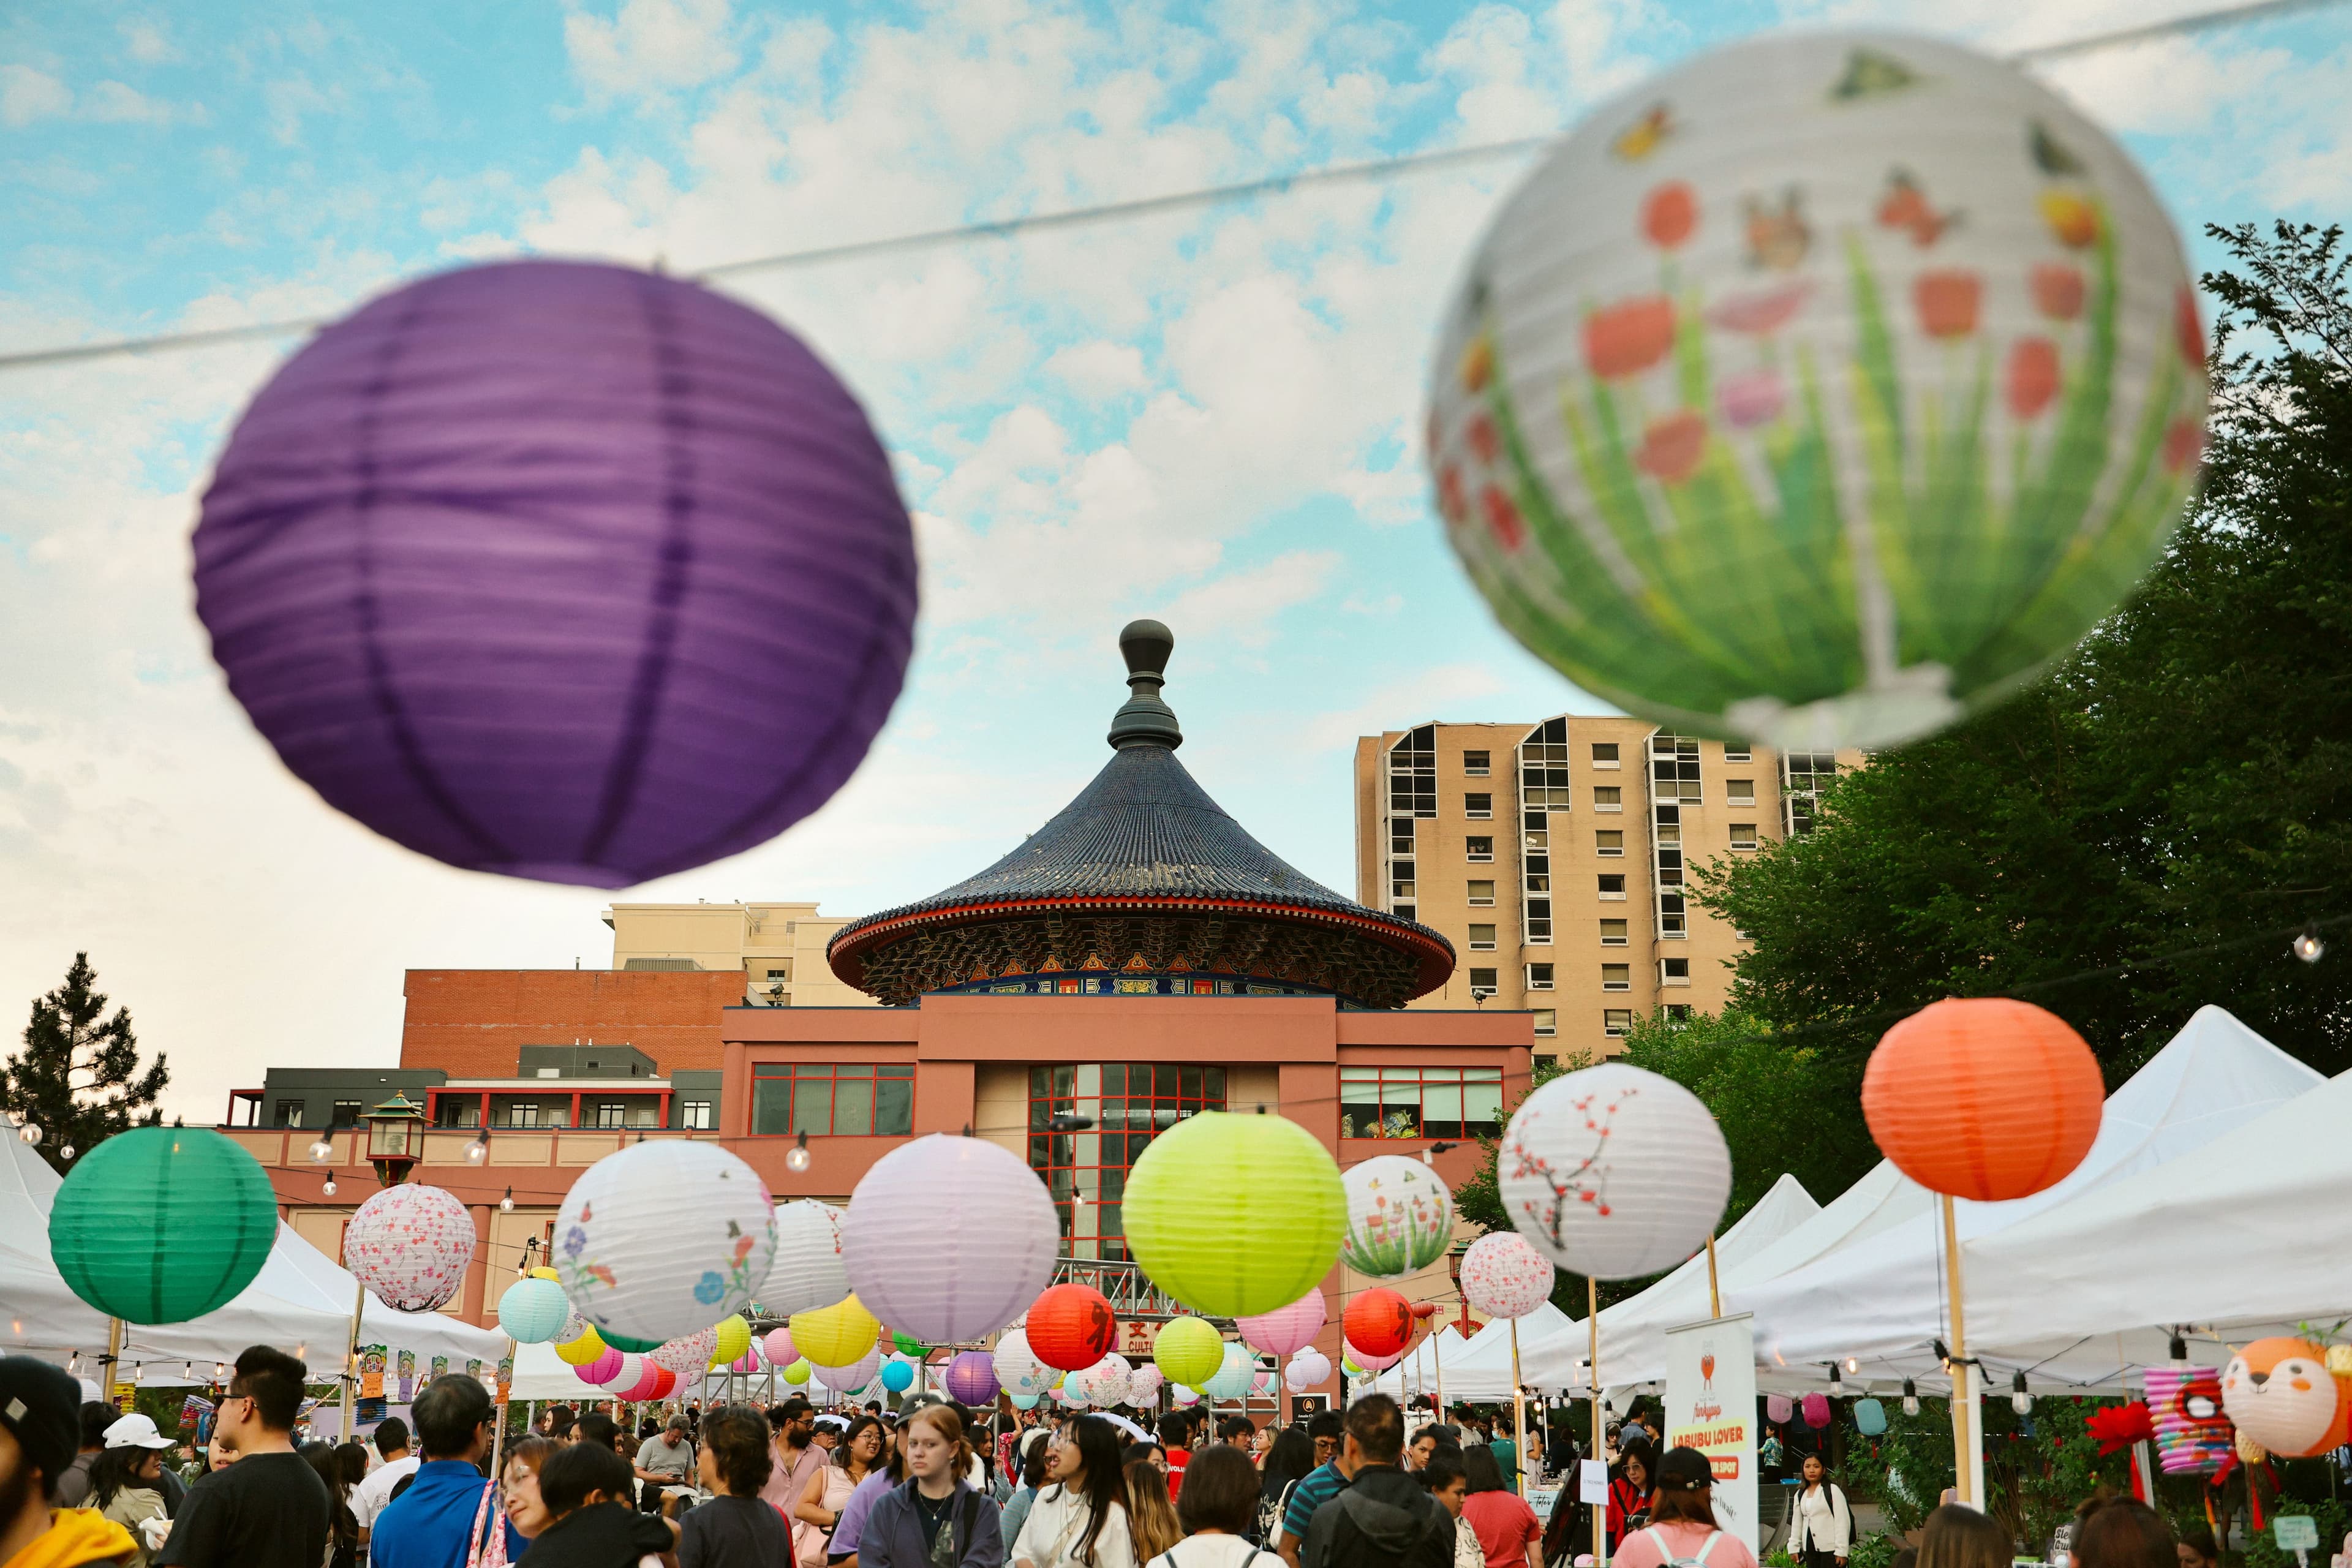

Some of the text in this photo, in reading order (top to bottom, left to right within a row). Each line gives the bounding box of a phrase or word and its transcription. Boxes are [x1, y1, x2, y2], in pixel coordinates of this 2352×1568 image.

[1673, 1426, 1743, 1449] LABUBU LOVER
[1719, 1461, 1736, 1474] SPOT
